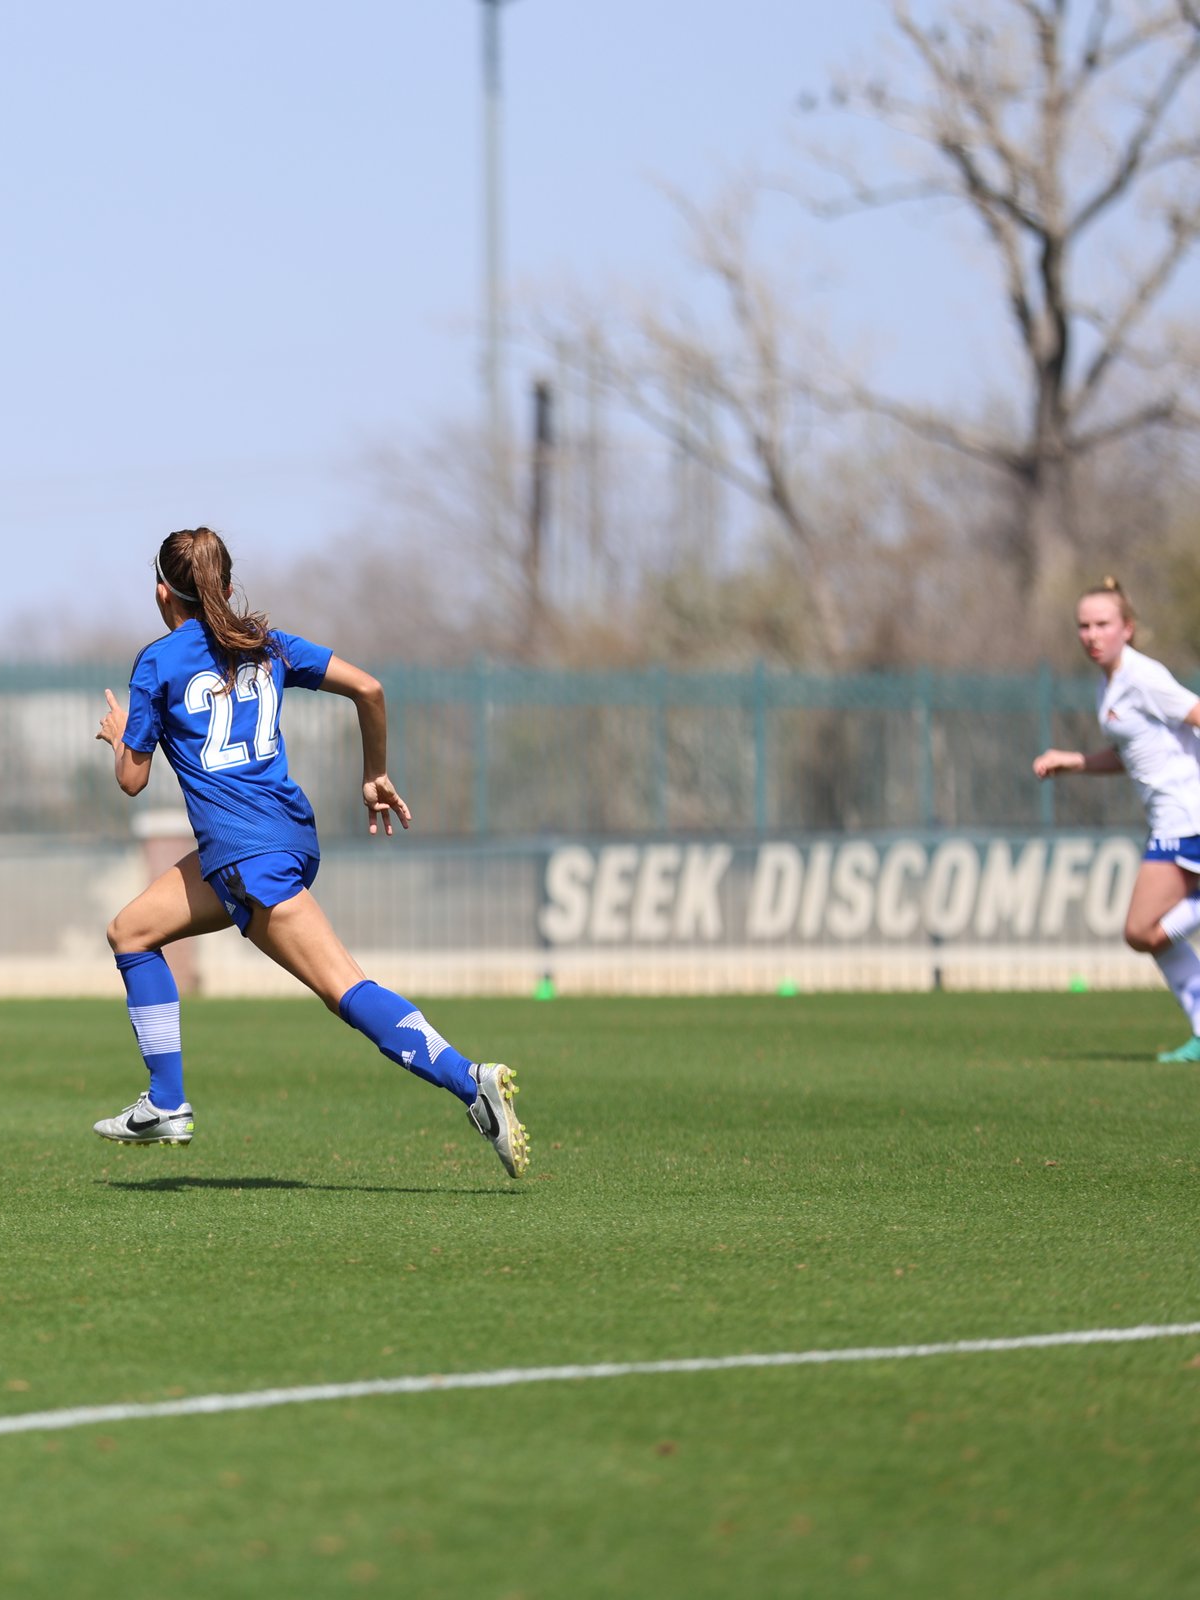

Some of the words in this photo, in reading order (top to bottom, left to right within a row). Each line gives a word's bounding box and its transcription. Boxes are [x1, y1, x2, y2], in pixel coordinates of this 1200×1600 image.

[184, 662, 279, 772] 22
[542, 843, 731, 942] SEEK
[747, 837, 1140, 938] DISCOMFO
